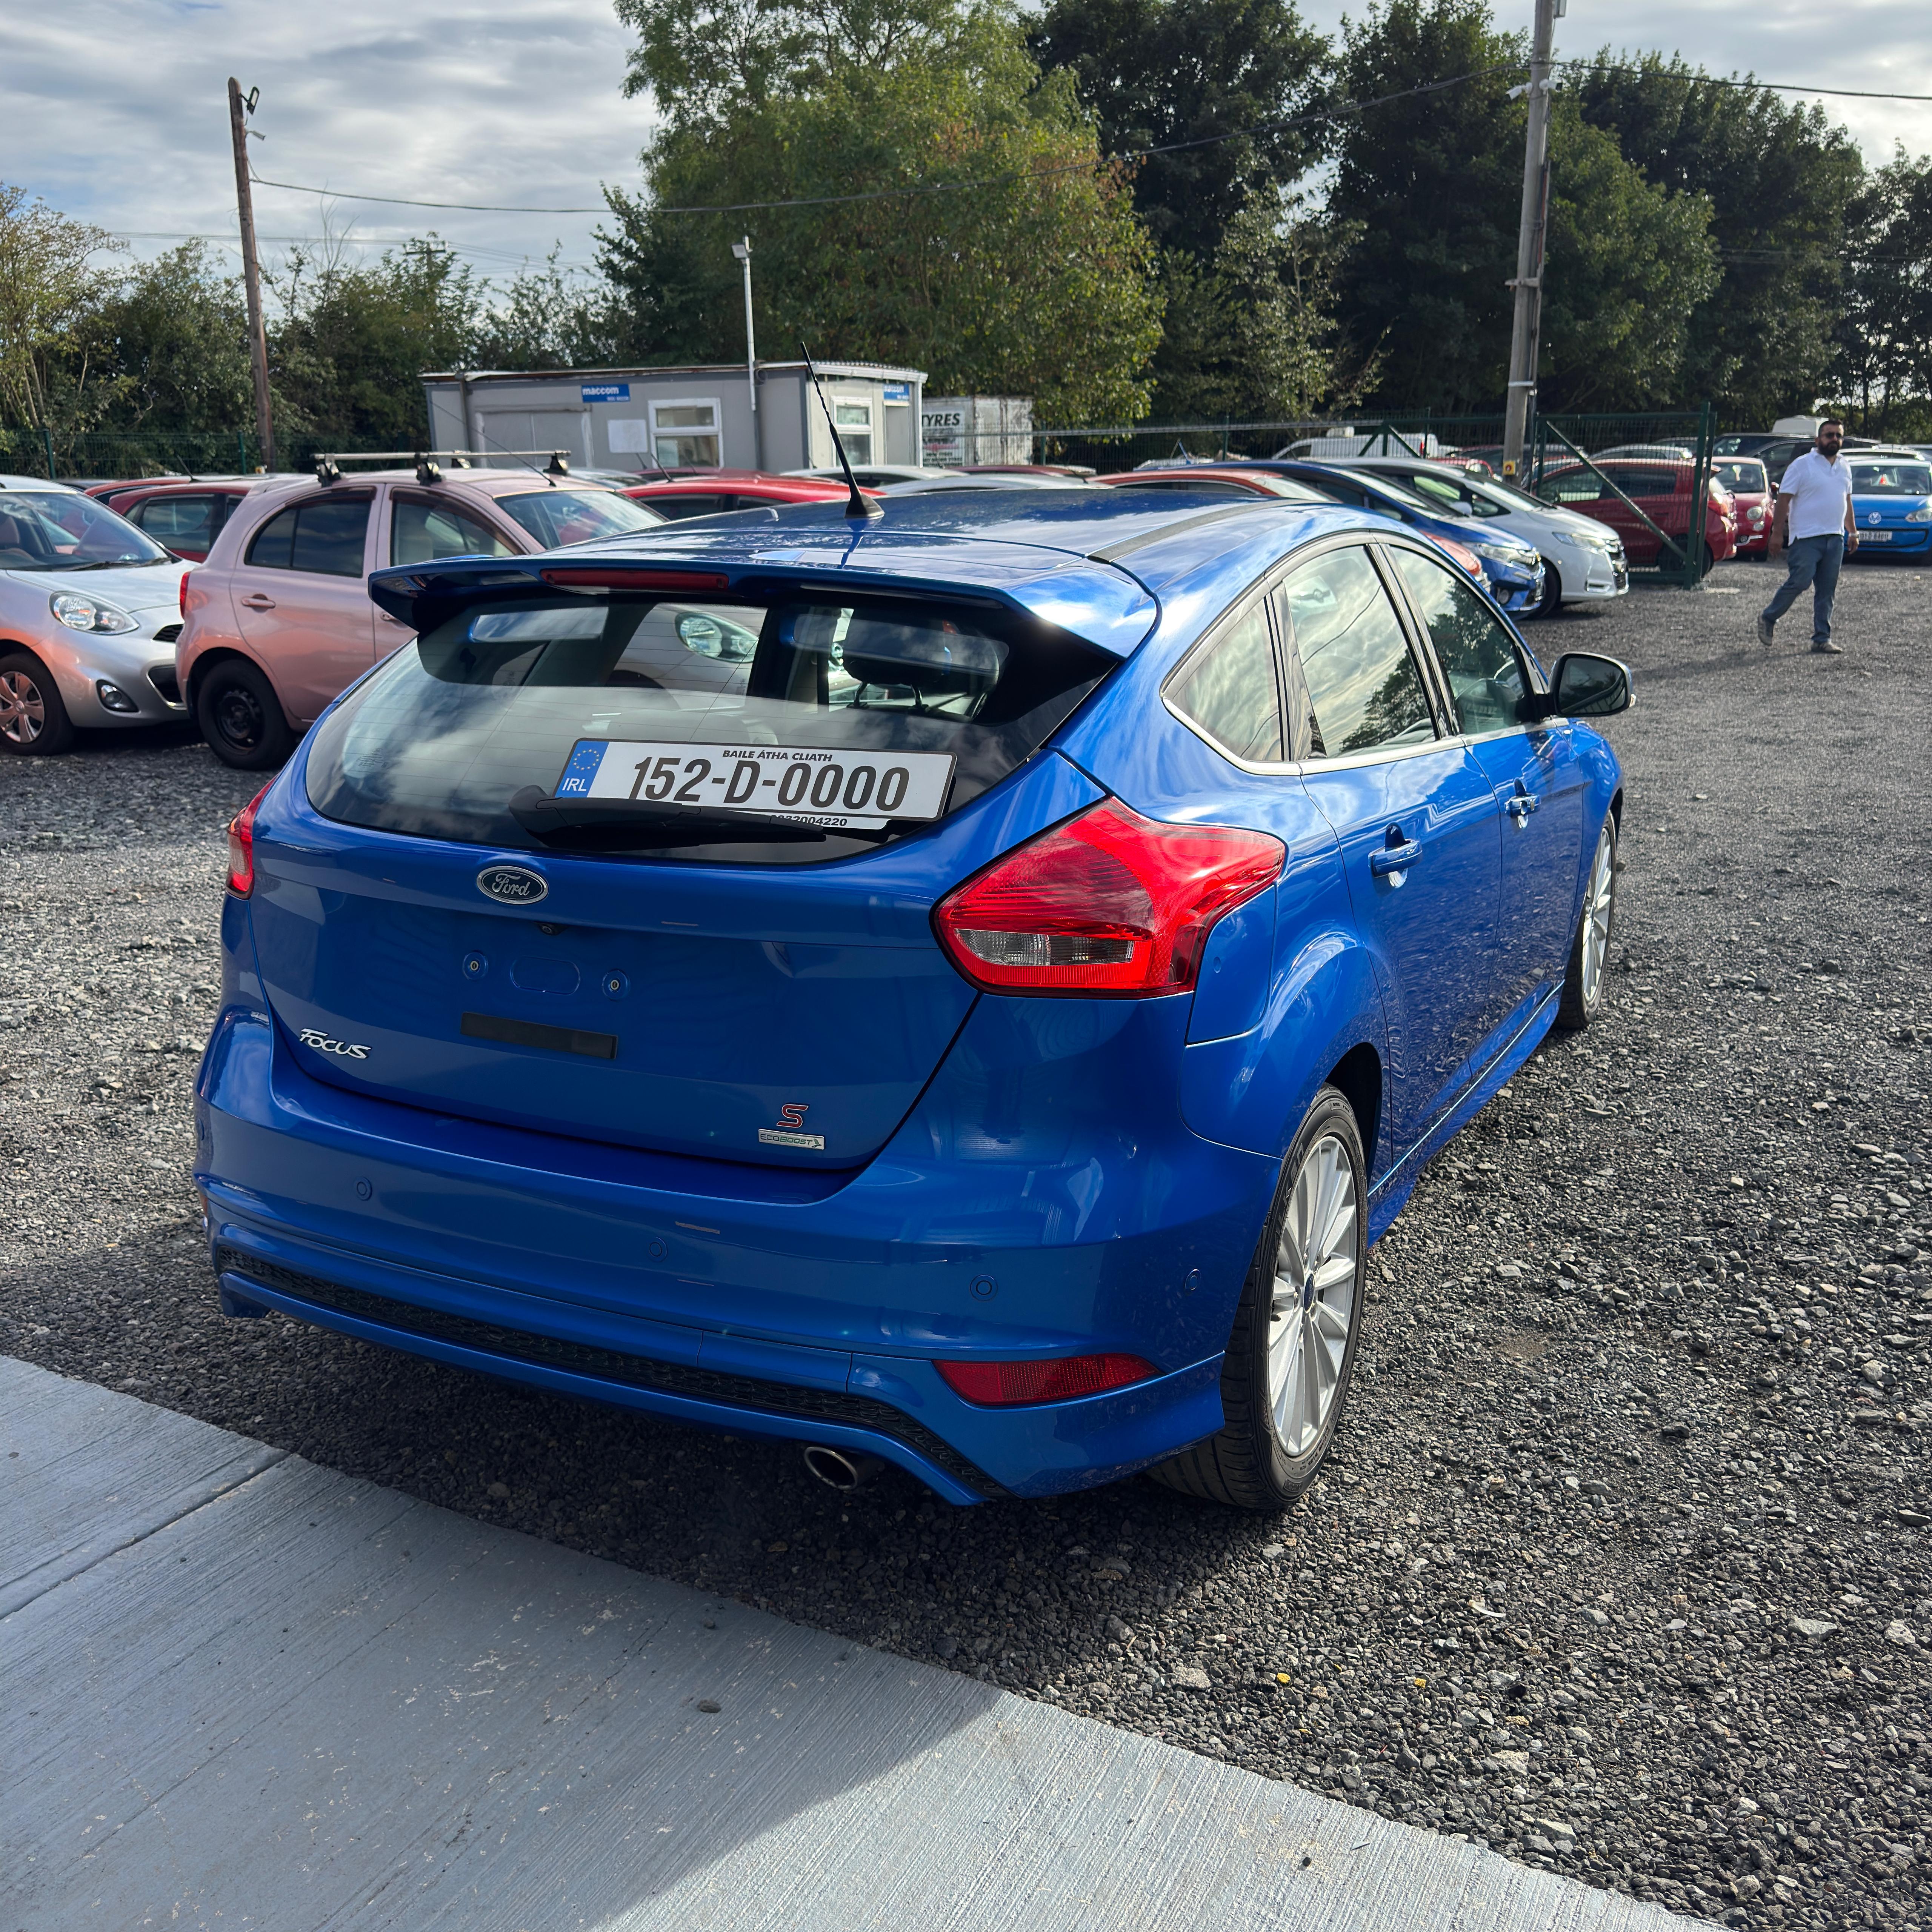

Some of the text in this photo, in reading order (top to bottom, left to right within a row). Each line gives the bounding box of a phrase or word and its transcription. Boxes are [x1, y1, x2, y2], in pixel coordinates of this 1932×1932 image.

[922, 413, 960, 426] TYRES
[723, 750, 832, 761] BAILE ÁTHA CLIATH
[562, 778, 587, 792] IRL
[629, 757, 909, 811] 152-D-0000
[492, 873, 530, 896] Ford
[776, 1103, 809, 1128] S
[760, 1134, 813, 1145] ECOBOOST
